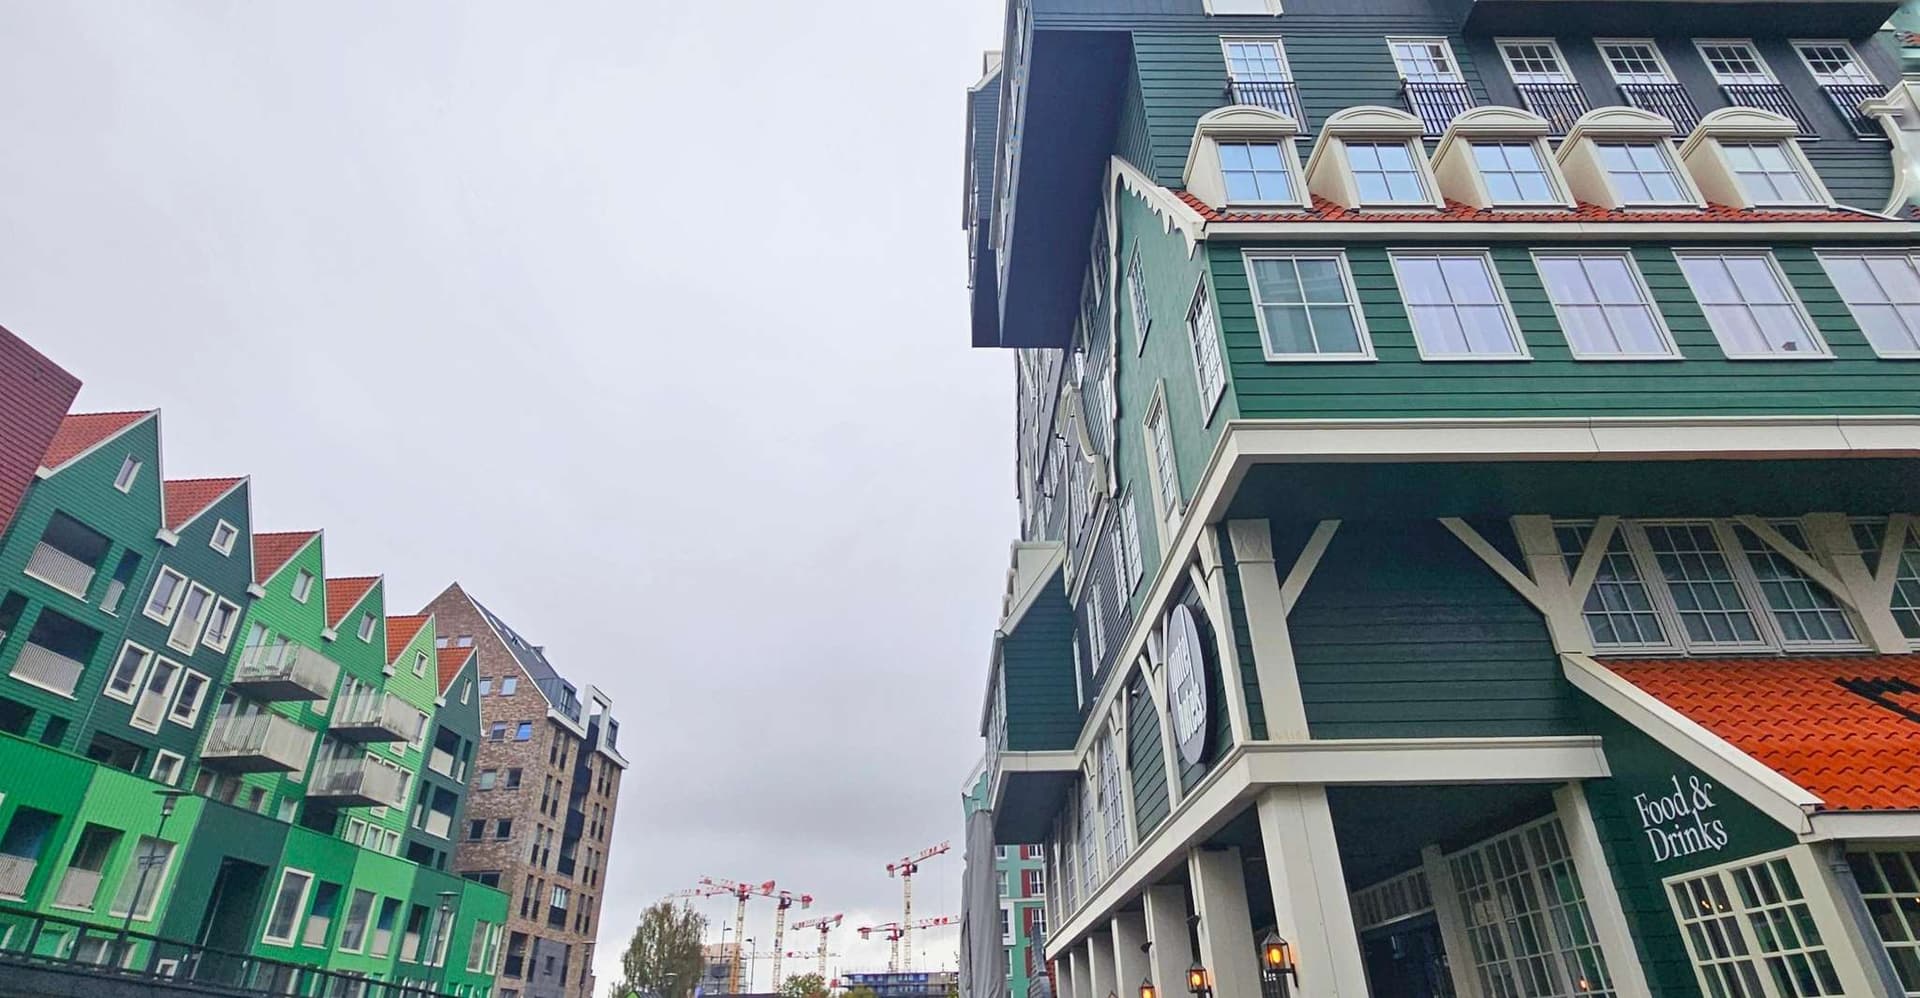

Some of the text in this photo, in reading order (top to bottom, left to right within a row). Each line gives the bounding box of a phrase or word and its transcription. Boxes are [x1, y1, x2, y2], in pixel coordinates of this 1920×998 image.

[1633, 774, 1716, 828] Food &
[1644, 807, 1728, 863] Drinks
